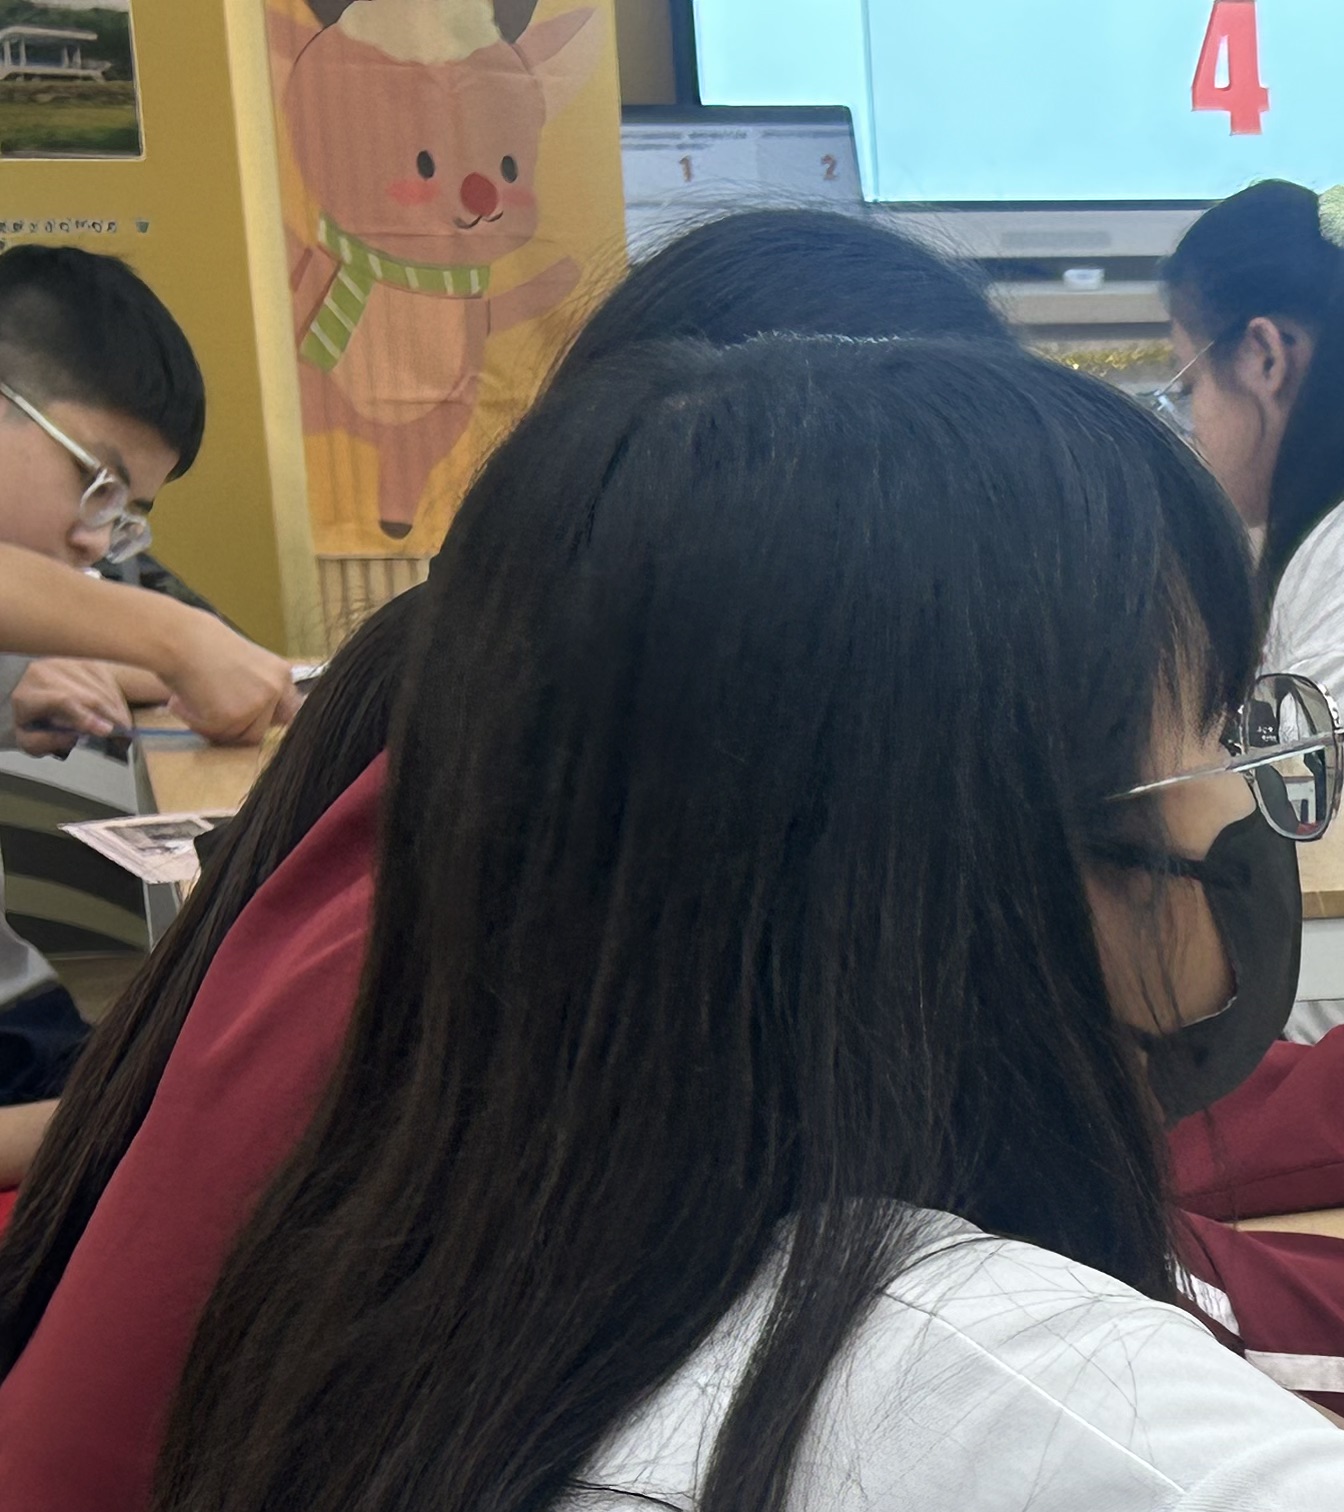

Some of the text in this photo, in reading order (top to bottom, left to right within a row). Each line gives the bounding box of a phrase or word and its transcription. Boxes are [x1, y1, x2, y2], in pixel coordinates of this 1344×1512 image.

[1191, 0, 1270, 136] 4
[679, 154, 694, 182] 1
[820, 153, 838, 181] 2
